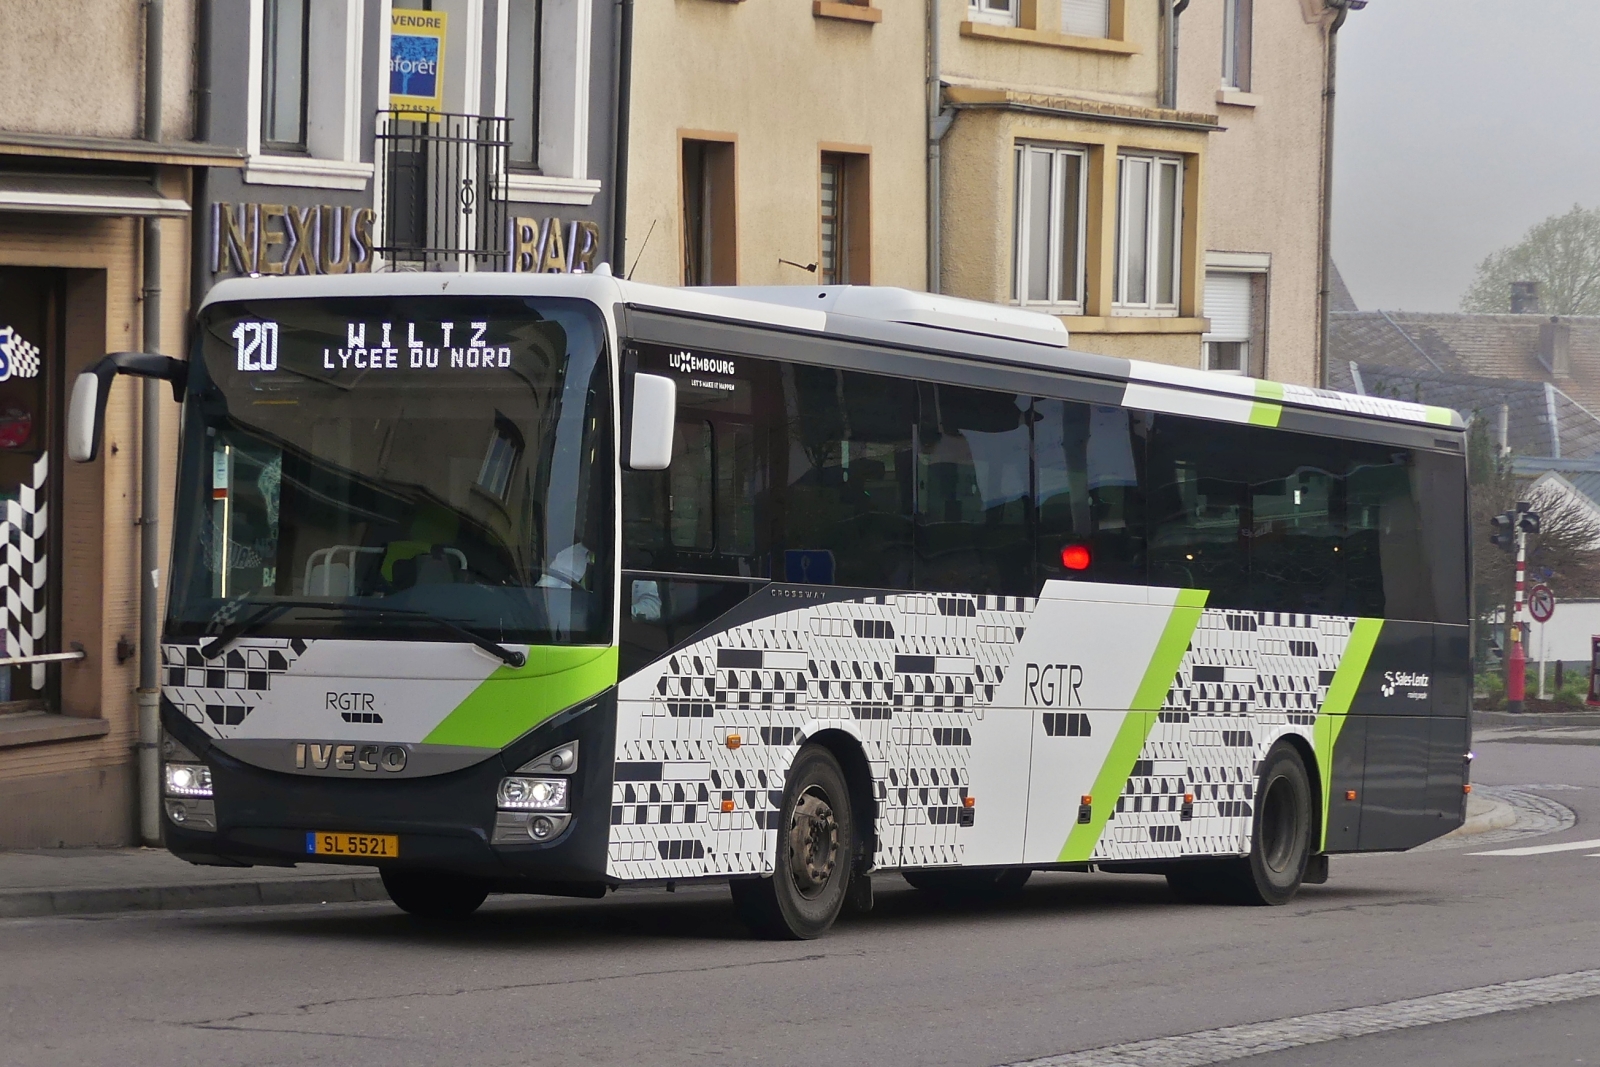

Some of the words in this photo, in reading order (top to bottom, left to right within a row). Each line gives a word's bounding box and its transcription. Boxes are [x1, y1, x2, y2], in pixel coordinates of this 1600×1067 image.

[391, 15, 441, 28] VENDRE
[211, 201, 377, 275] NEXUS
[506, 216, 600, 273] BAR
[232, 322, 279, 371] 120
[347, 322, 487, 348] WILTZ
[323, 348, 399, 368] LYCEE
[410, 348, 439, 368] DU
[450, 347, 511, 368] NORD
[669, 351, 735, 375] LUXEMBOURG
[771, 589, 826, 600] CROSSWAY
[1024, 662, 1083, 707] RGTR
[325, 691, 375, 711] RGTR
[296, 743, 408, 773] IVECO
[324, 836, 344, 853] SL
[348, 836, 387, 855] 5521
